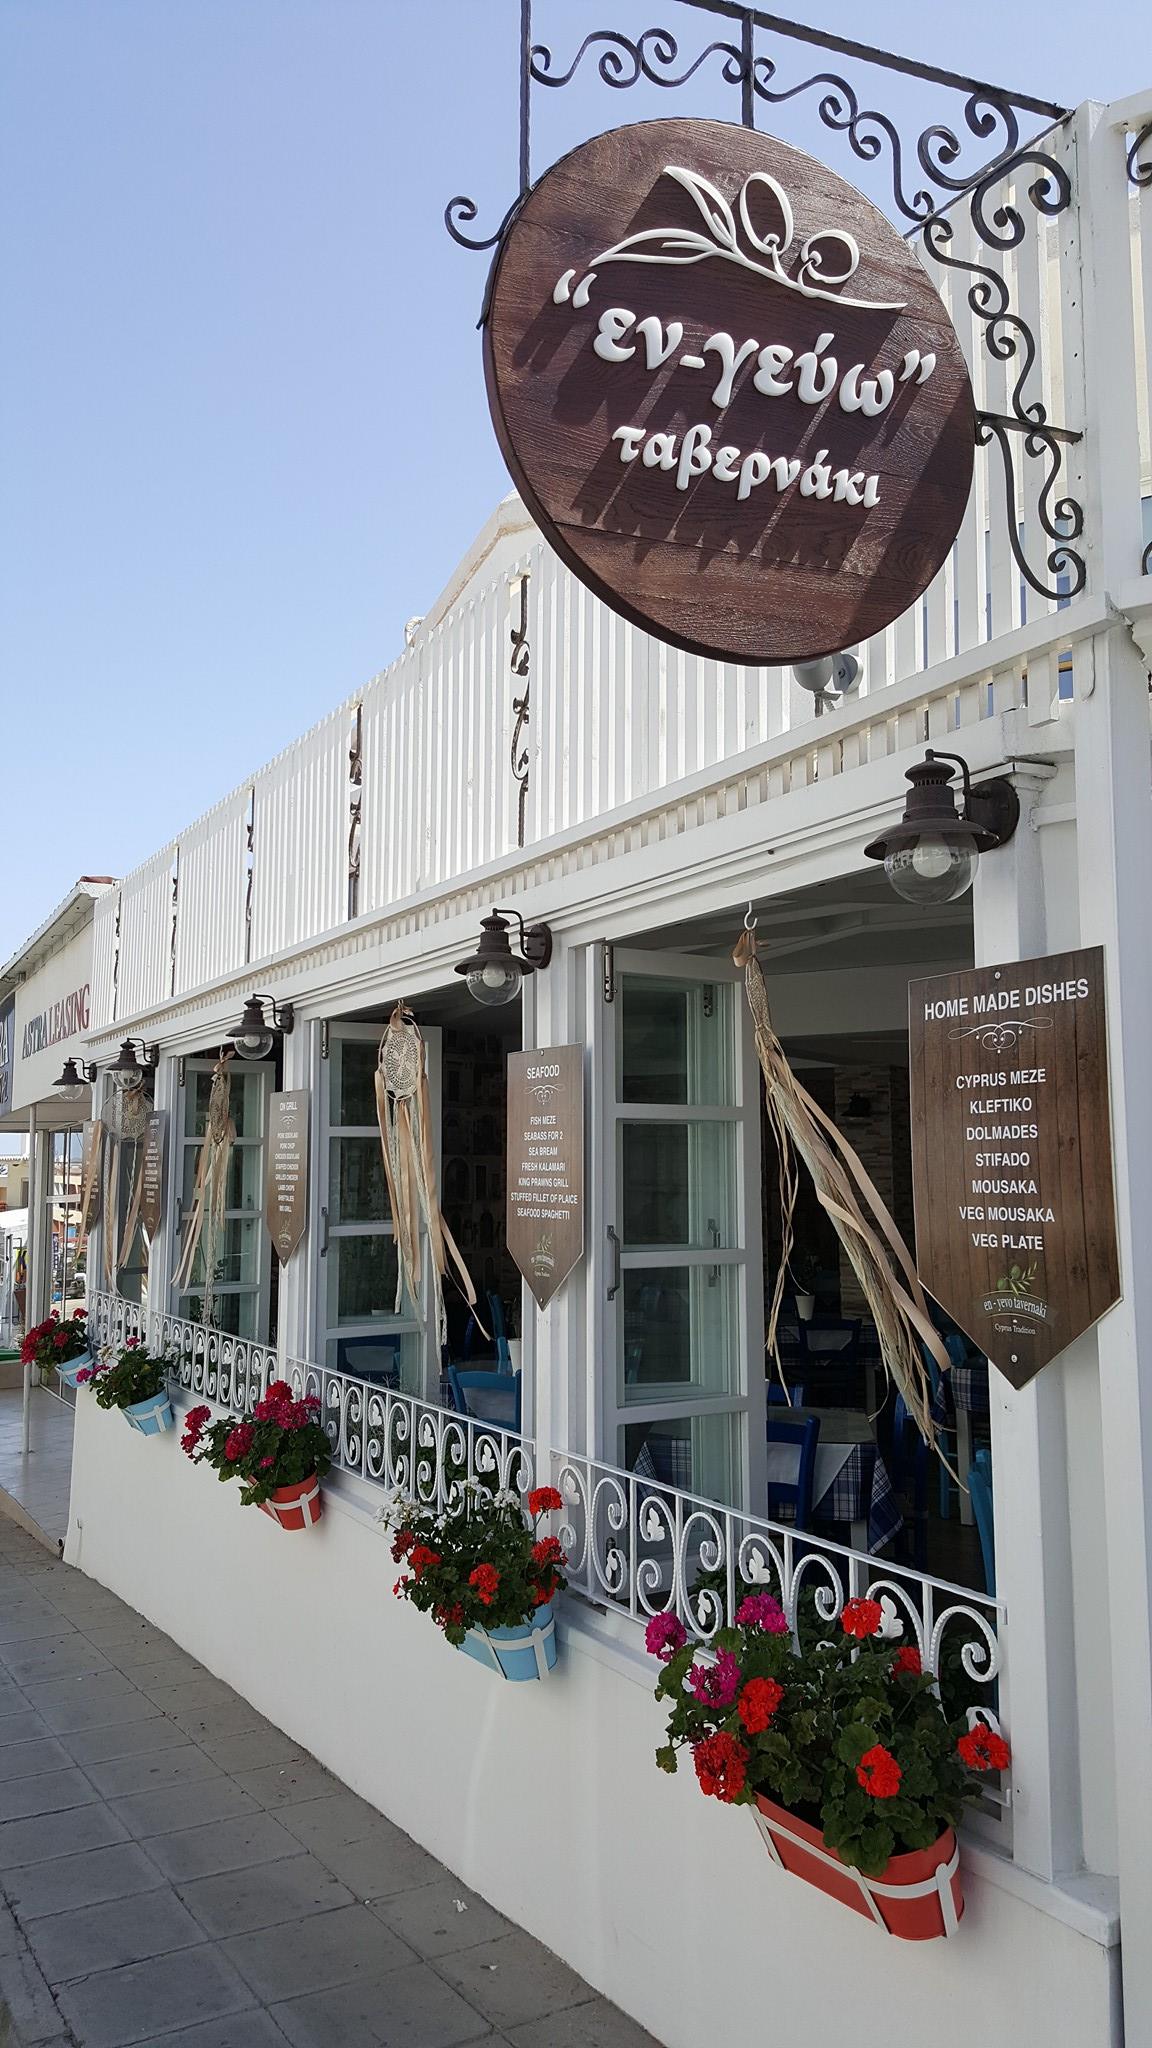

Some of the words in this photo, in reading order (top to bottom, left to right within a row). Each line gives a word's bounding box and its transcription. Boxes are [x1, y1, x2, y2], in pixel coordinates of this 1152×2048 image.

[611, 423, 881, 509] ταβερνάκι
[924, 998, 969, 1021] HOME
[973, 990, 1020, 1014] MADE
[1025, 978, 1089, 1006] DISHES
[22, 1011, 48, 1060] ASTRA
[48, 983, 90, 1046] LEASING
[526, 1064, 560, 1080] SEAFOOD
[956, 1072, 1007, 1089] CYPRUS
[1010, 1068, 1047, 1085] MEZE
[970, 1097, 1032, 1114] KLEFTIKO
[530, 1116, 541, 1126] FISH
[542, 1115, 557, 1125] MEZE
[523, 1131, 548, 1141] SEABASS
[547, 1131, 559, 1141] FOR
[559, 1131, 564, 1140] 2
[966, 1124, 1038, 1141] DOLMADES
[528, 1147, 539, 1156] SEA
[539, 1146, 558, 1156] BREAM
[521, 1162, 538, 1171] FRESH
[538, 1162, 566, 1171] KALAMARI
[975, 1152, 1030, 1167] STIFADO
[518, 1177, 531, 1186] KING
[530, 1177, 552, 1187] PRAWNS
[552, 1177, 569, 1188] GRILL
[972, 1179, 1038, 1194] MOUSAKA
[510, 1192, 532, 1202] STUFFED
[532, 1193, 550, 1203] FILLET
[550, 1193, 558, 1203] OF
[558, 1194, 578, 1204] PLAICE
[516, 1207, 541, 1218] SEAFOOD
[540, 1208, 570, 1220] SPAGHETTI
[959, 1206, 985, 1221] VEG
[988, 1207, 1056, 1223] MOUSAKA
[971, 1233, 998, 1248] VEG
[1002, 1234, 1044, 1250] PLATE
[1013, 1296, 1047, 1318] tavernaki
[994, 1323, 1012, 1333] Cyprus
[1012, 1324, 1036, 1335] Tradition
